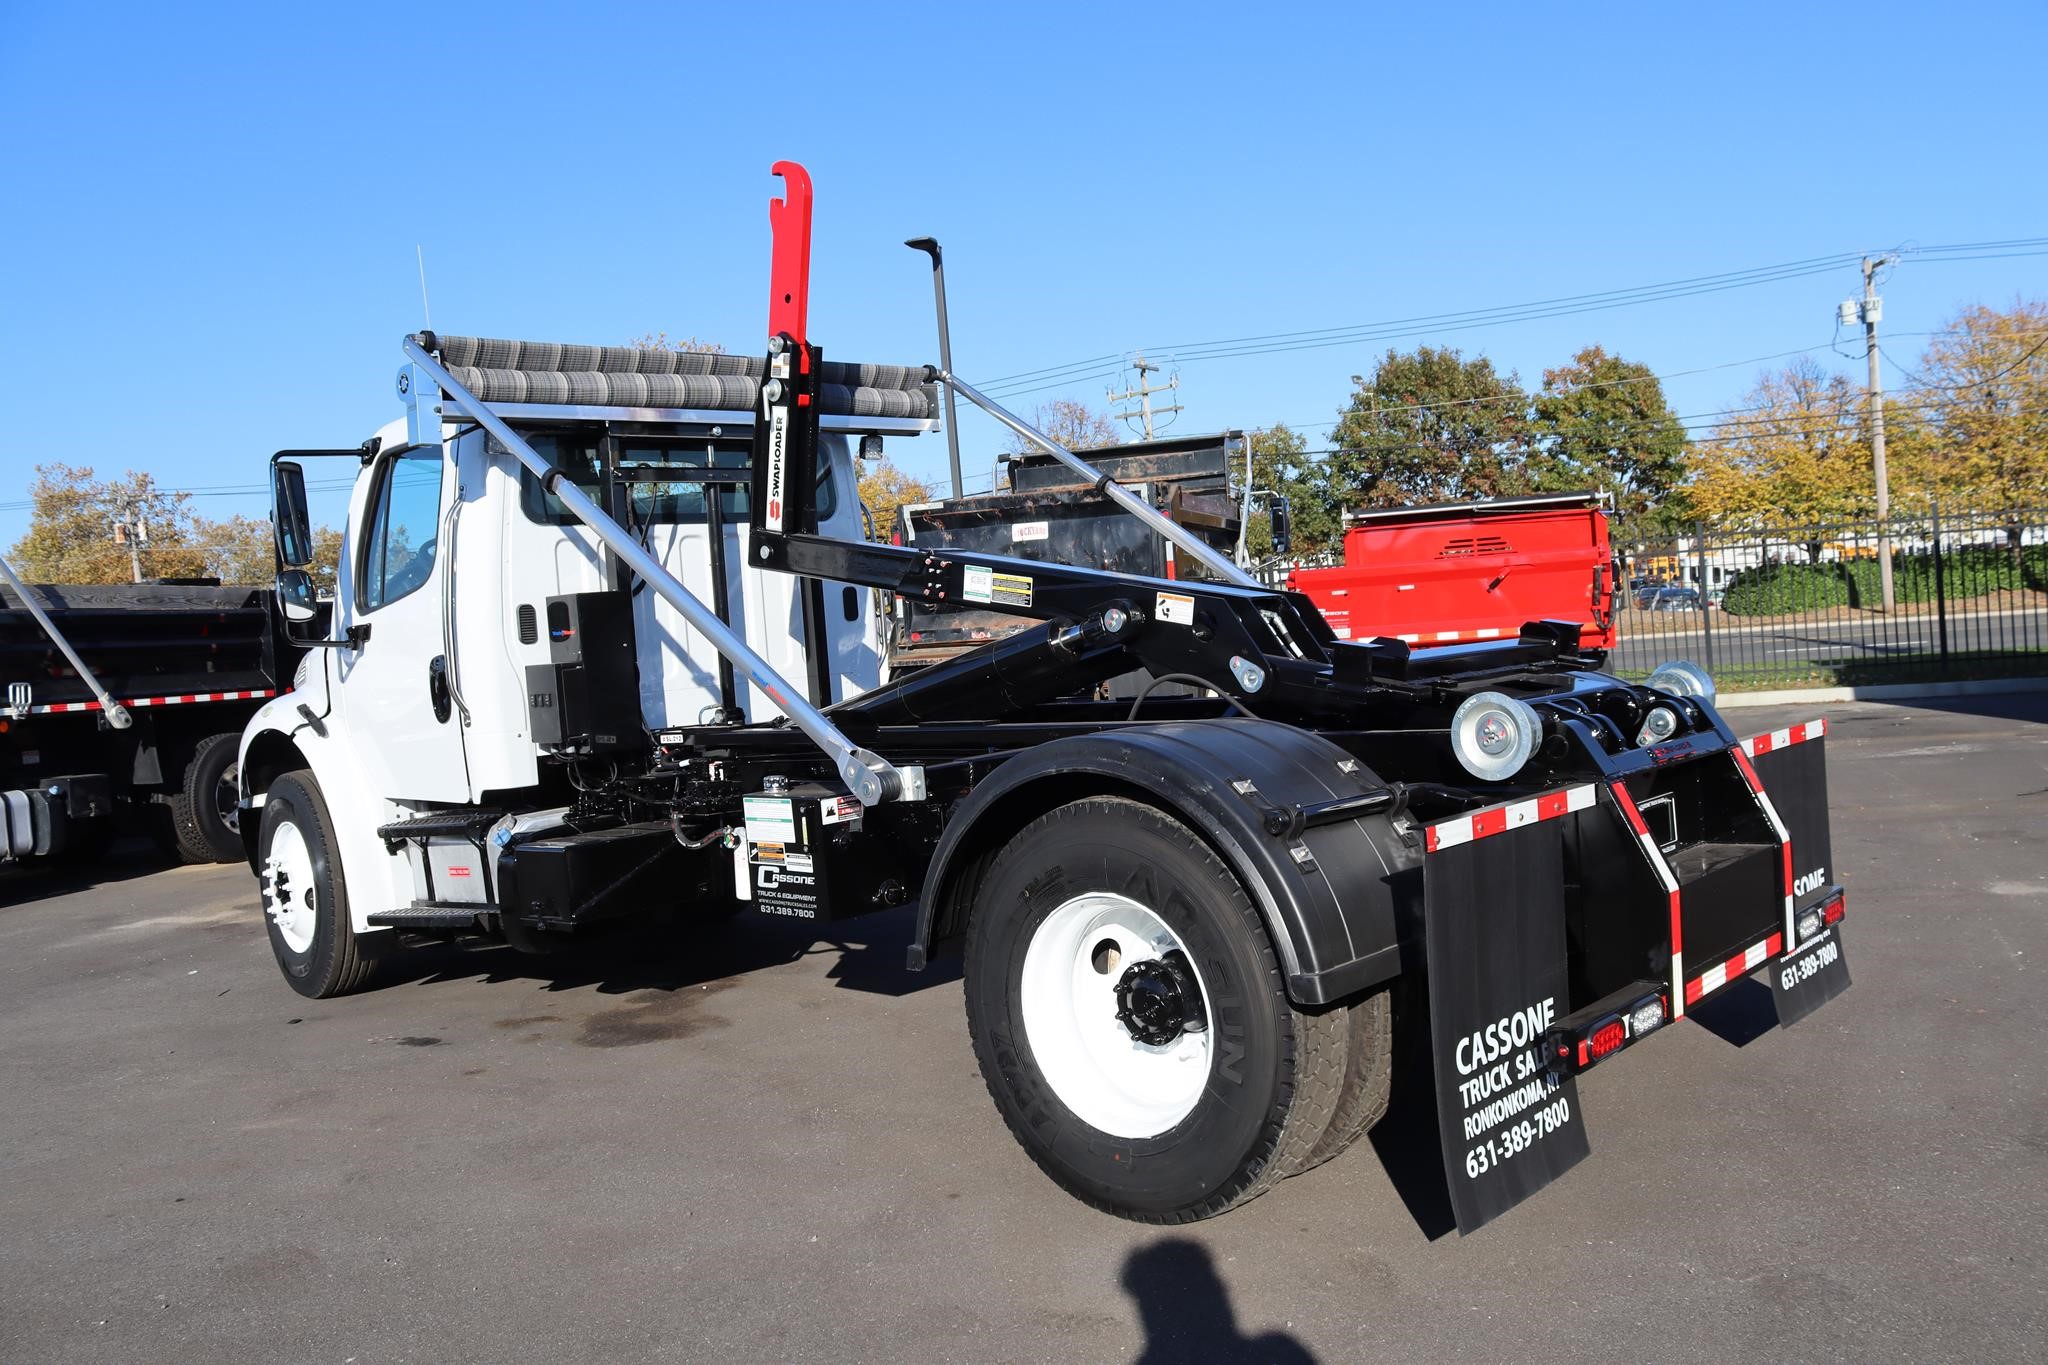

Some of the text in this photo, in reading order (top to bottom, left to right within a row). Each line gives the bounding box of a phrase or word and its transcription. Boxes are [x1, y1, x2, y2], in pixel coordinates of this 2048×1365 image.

[772, 417, 783, 497] SWAPLOADER
[757, 865, 815, 889] CASSONE
[757, 890, 777, 899] TRUCK
[782, 893, 817, 902] EQUIPMENT
[760, 905, 815, 919] 631.389.7800
[1781, 941, 1838, 991] 631-389-7800
[1456, 997, 1555, 1075] CASSONE
[1459, 1041, 1549, 1109] TRUCK SALE
[1464, 1071, 1560, 1141] RONKONKOMA, NY
[1466, 1097, 1570, 1179] 631-389-7800
